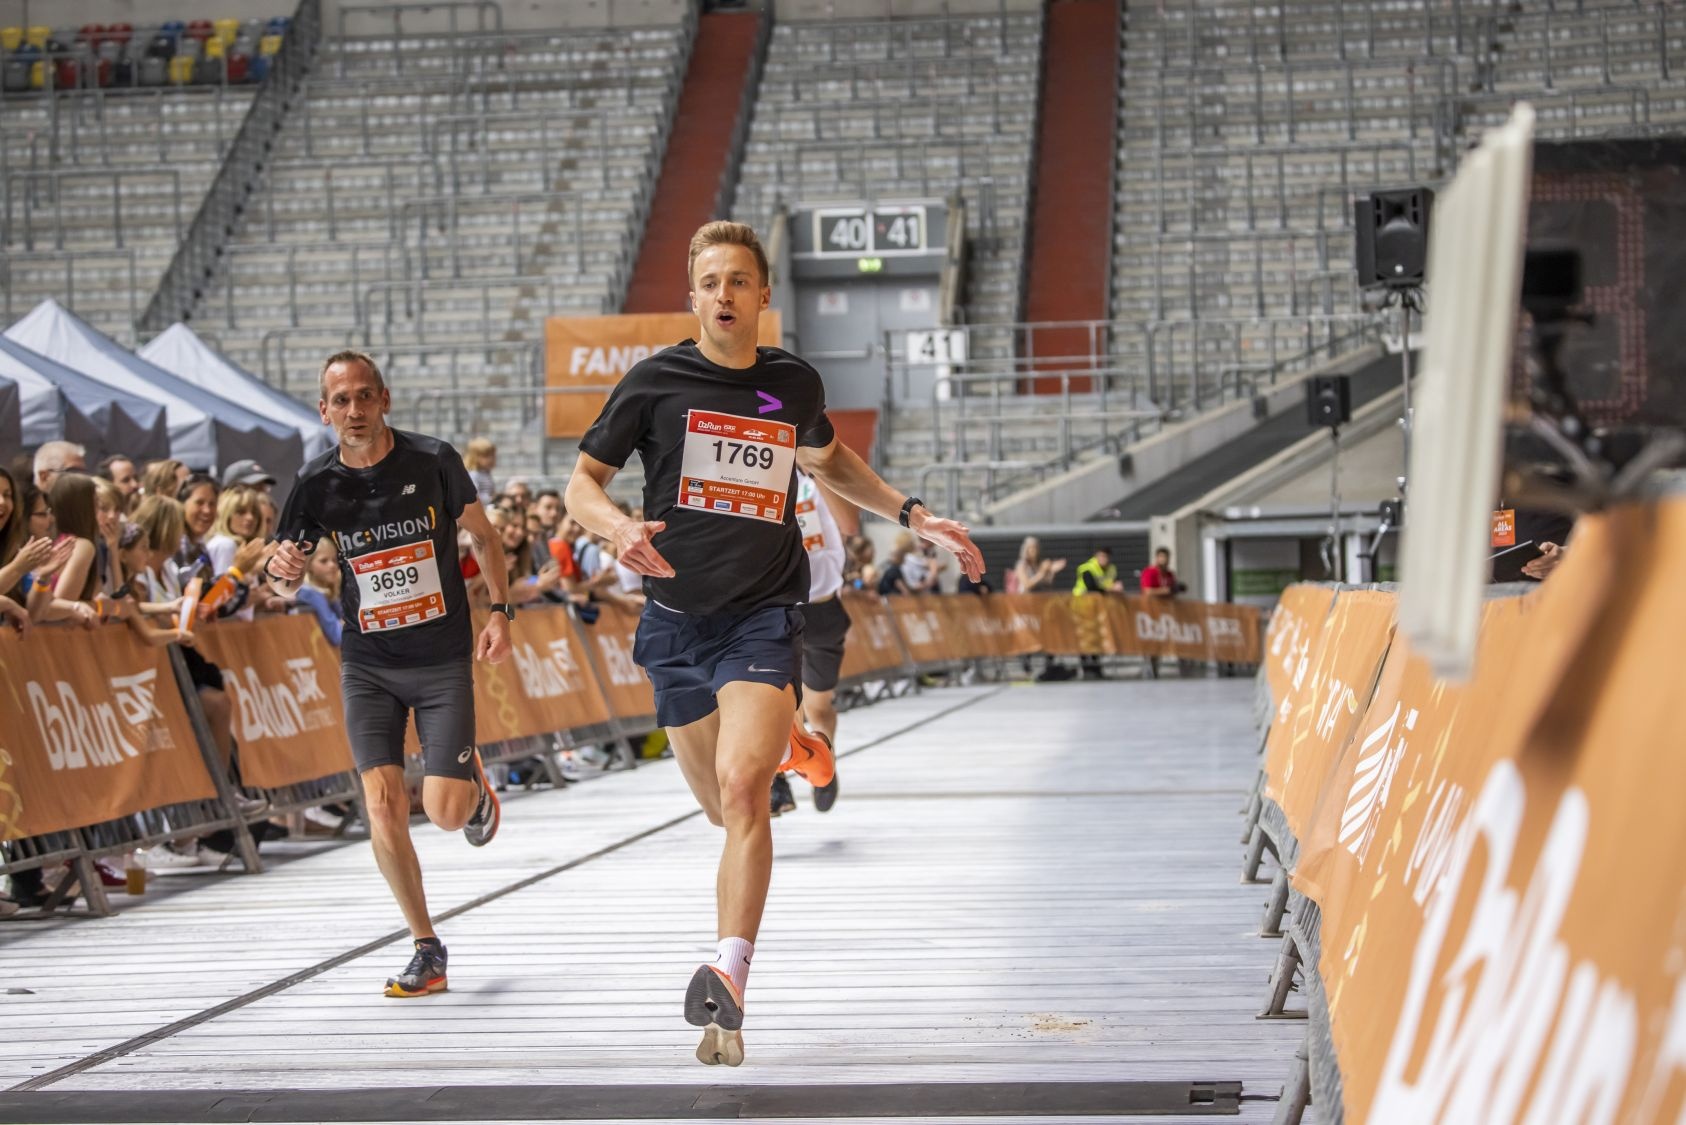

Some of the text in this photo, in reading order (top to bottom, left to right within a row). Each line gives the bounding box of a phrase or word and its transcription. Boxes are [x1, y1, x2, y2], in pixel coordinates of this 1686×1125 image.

[829, 218, 866, 250] 40
[886, 216, 919, 248] 41
[920, 334, 951, 362] 41
[712, 440, 774, 470] 1769
[708, 486, 740, 495] STARTZEIT
[773, 494, 780, 504] D
[370, 566, 419, 592] 3699
[384, 588, 410, 598] VOLKER
